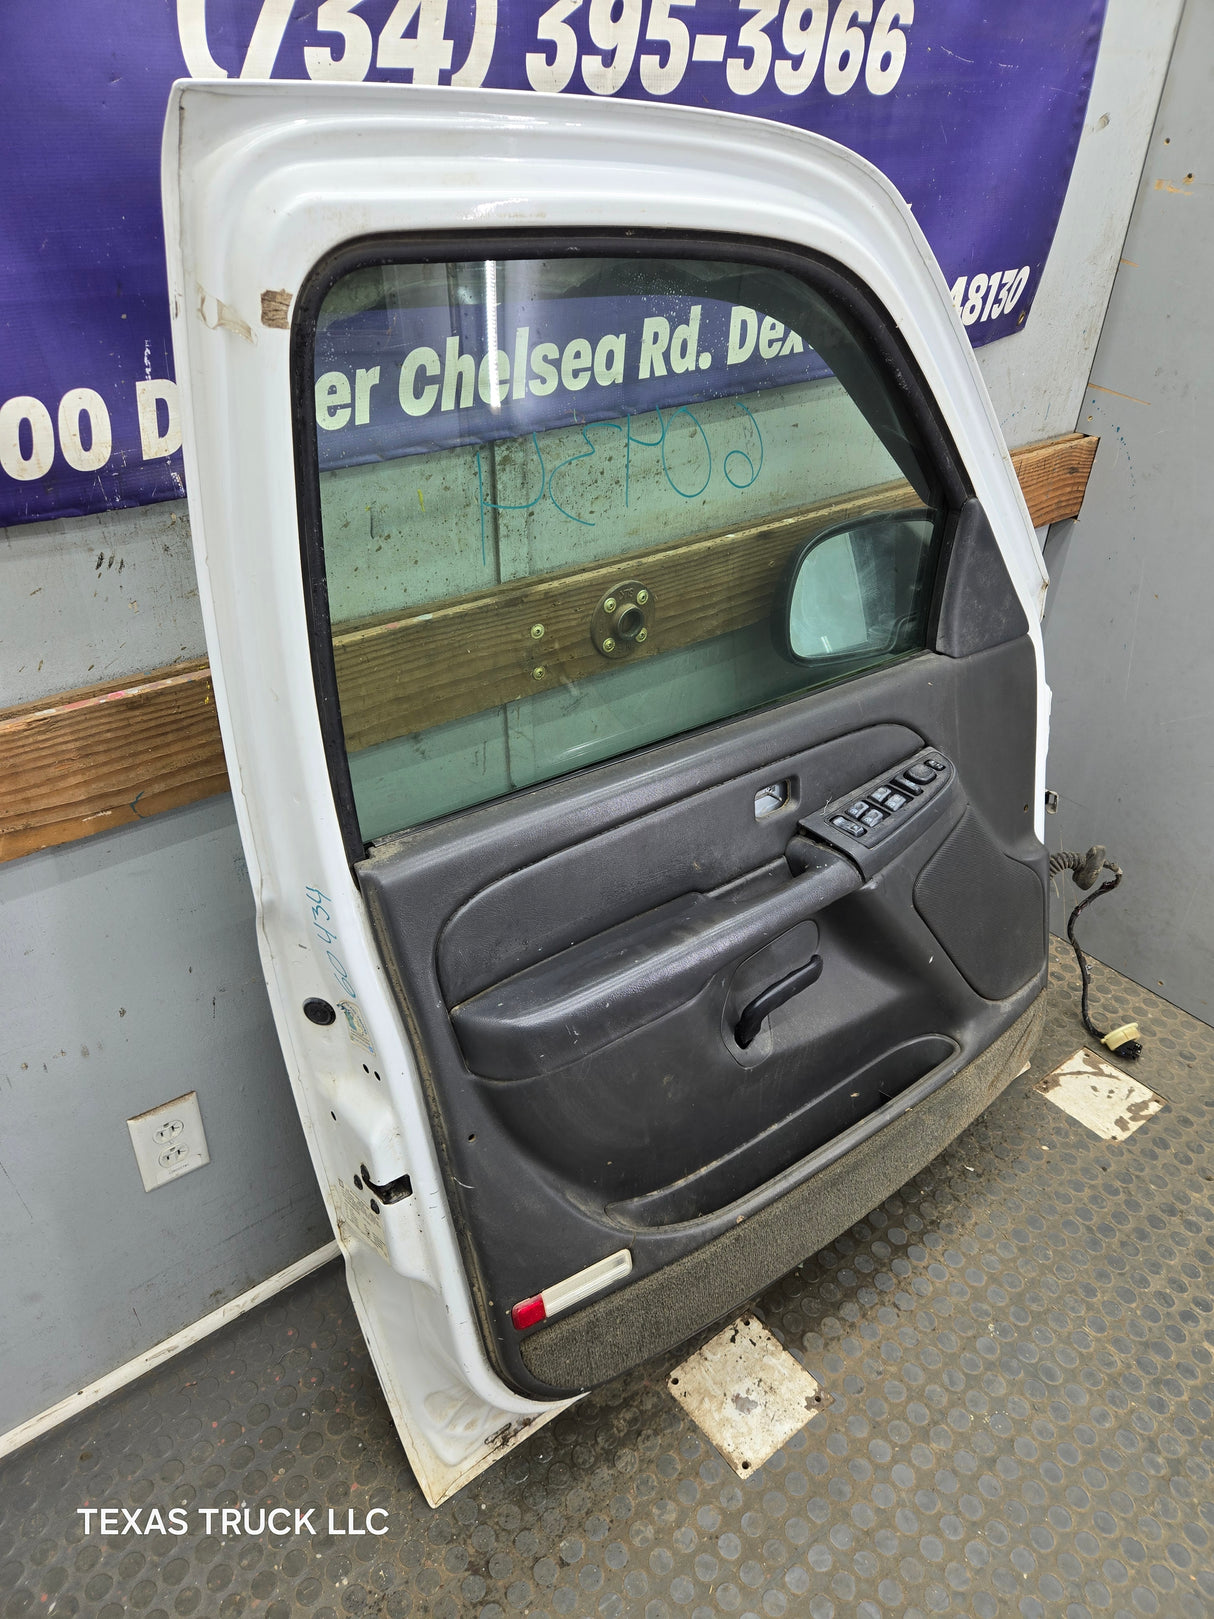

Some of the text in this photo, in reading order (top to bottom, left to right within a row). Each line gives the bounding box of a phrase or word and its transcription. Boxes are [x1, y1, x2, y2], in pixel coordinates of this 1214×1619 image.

[525, 0, 914, 96] 395-3966
[399, 326, 626, 416] Chelsea
[638, 304, 712, 379] Rd.
[727, 305, 814, 365] Dex
[950, 265, 1030, 326] 48130
